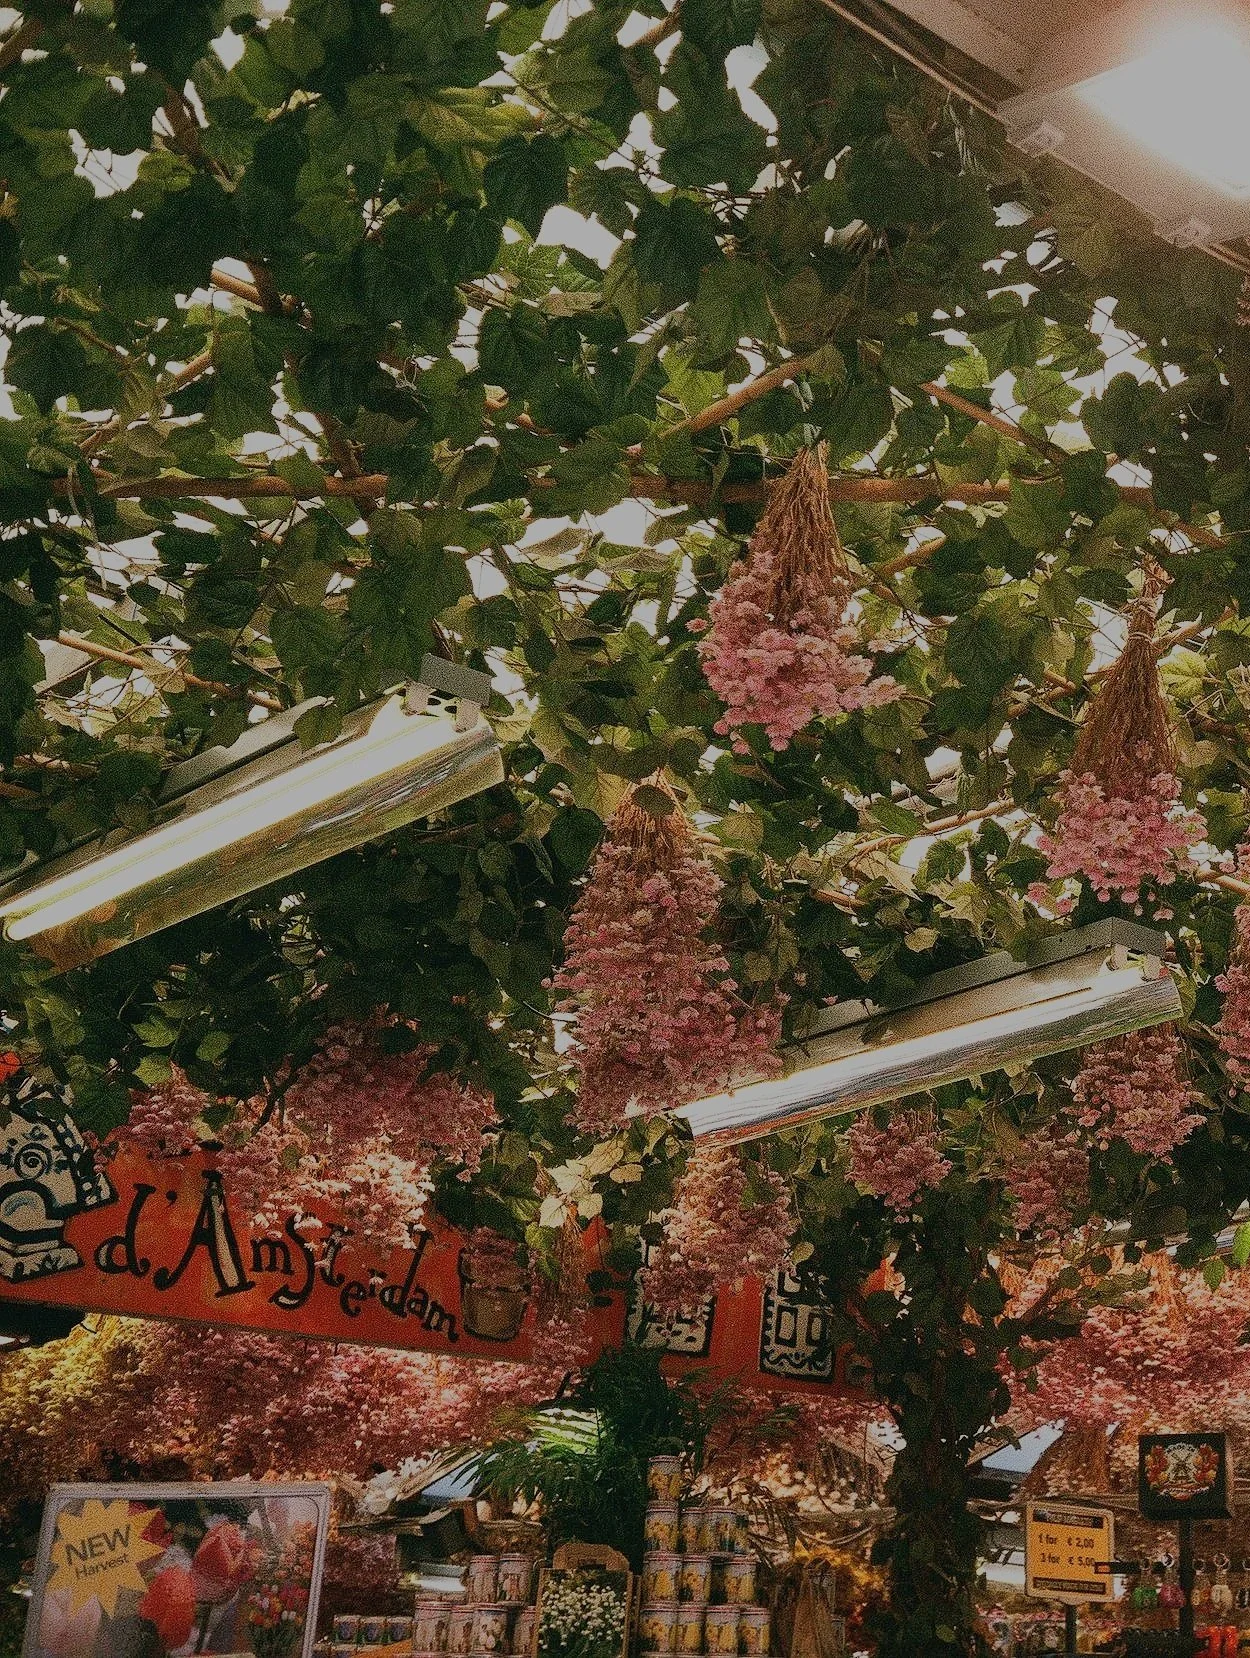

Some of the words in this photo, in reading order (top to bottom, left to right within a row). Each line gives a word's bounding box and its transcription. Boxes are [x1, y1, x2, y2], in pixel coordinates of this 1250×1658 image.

[65, 1524, 131, 1567] NEW
[1046, 1534, 1058, 1544] for
[1075, 1537, 1094, 1549] 2,00
[75, 1553, 129, 1580] Harvest
[1048, 1553, 1060, 1564] for
